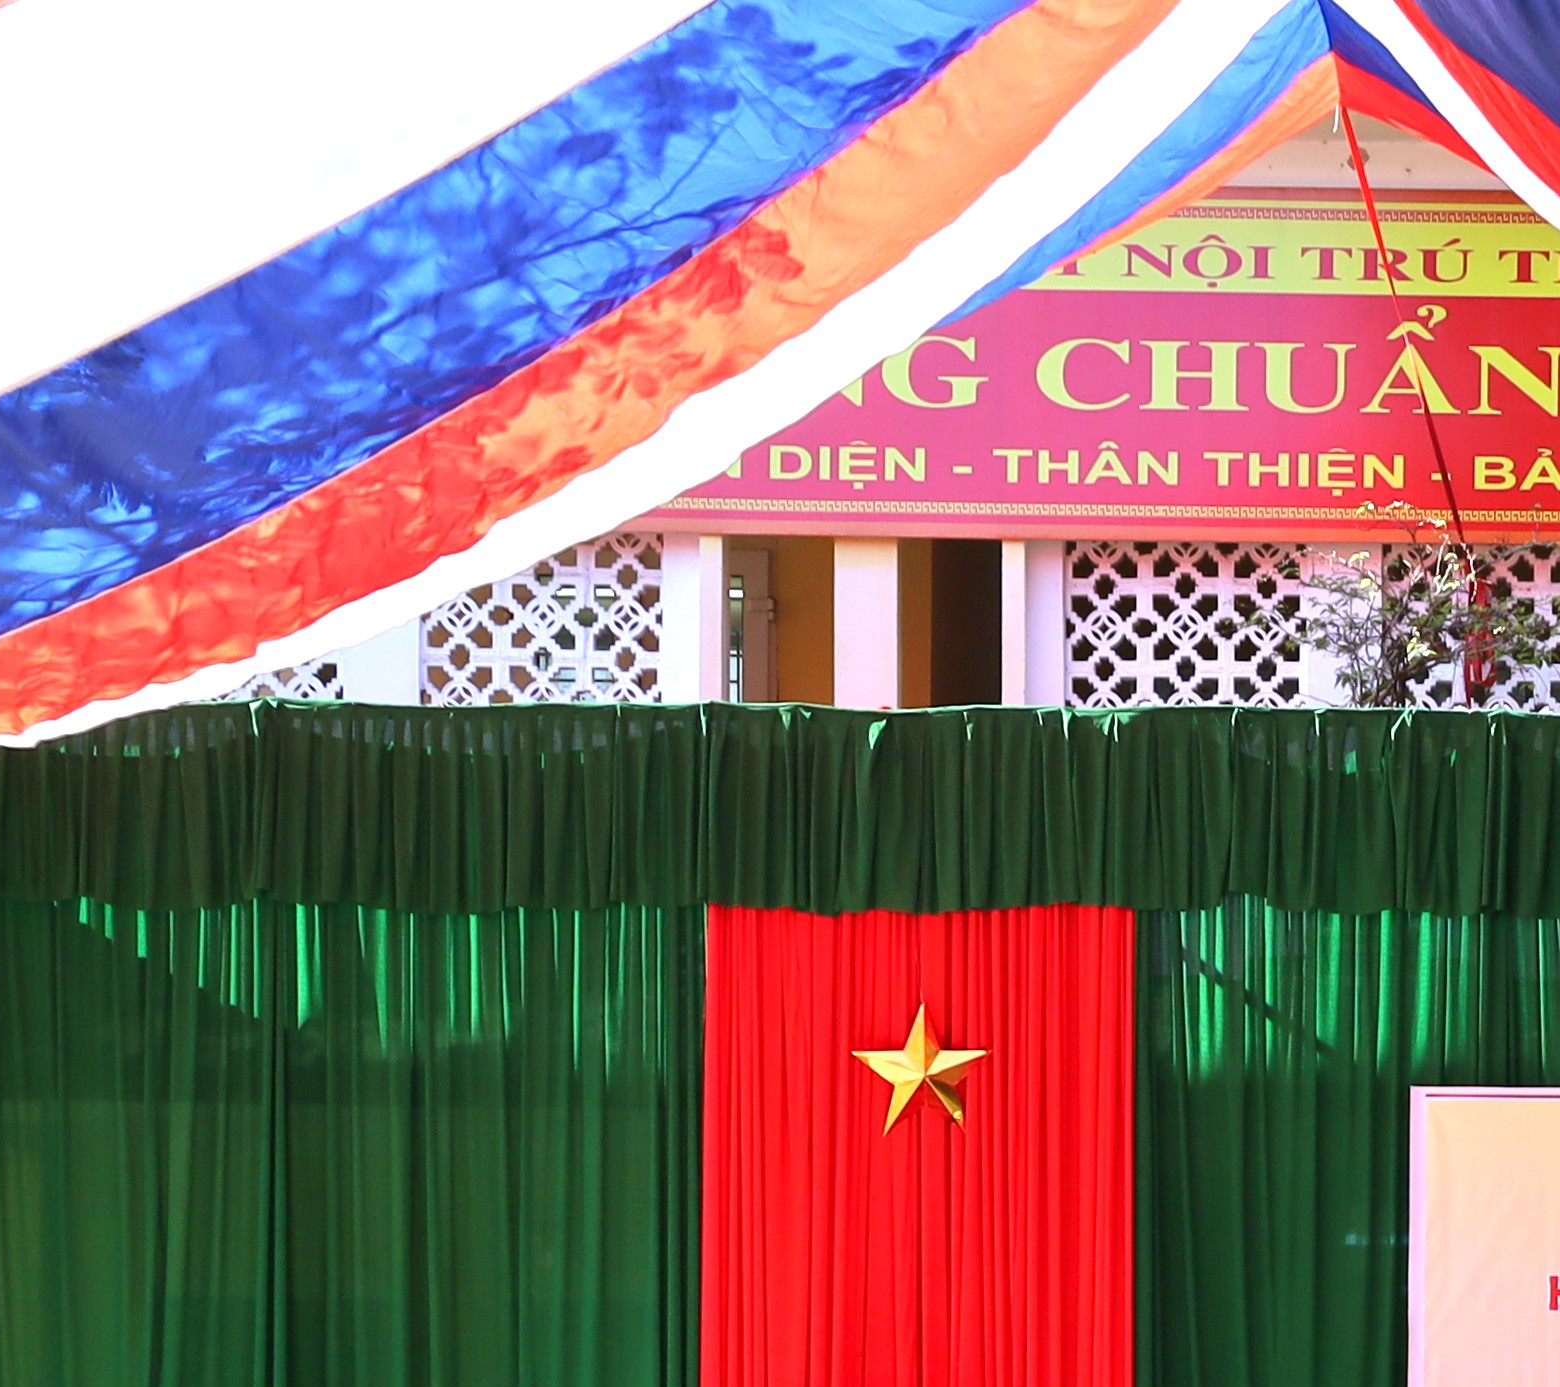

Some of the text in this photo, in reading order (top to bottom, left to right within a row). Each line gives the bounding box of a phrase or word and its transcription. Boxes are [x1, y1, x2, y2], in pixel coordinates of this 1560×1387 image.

[1122, 234, 1276, 288] NỘI
[1300, 238, 1474, 284] TRÚ
[841, 335, 989, 408] G
[769, 440, 926, 489] DIỆN
[992, 441, 1179, 487] THÂN
[1203, 448, 1405, 496] THIỆN
